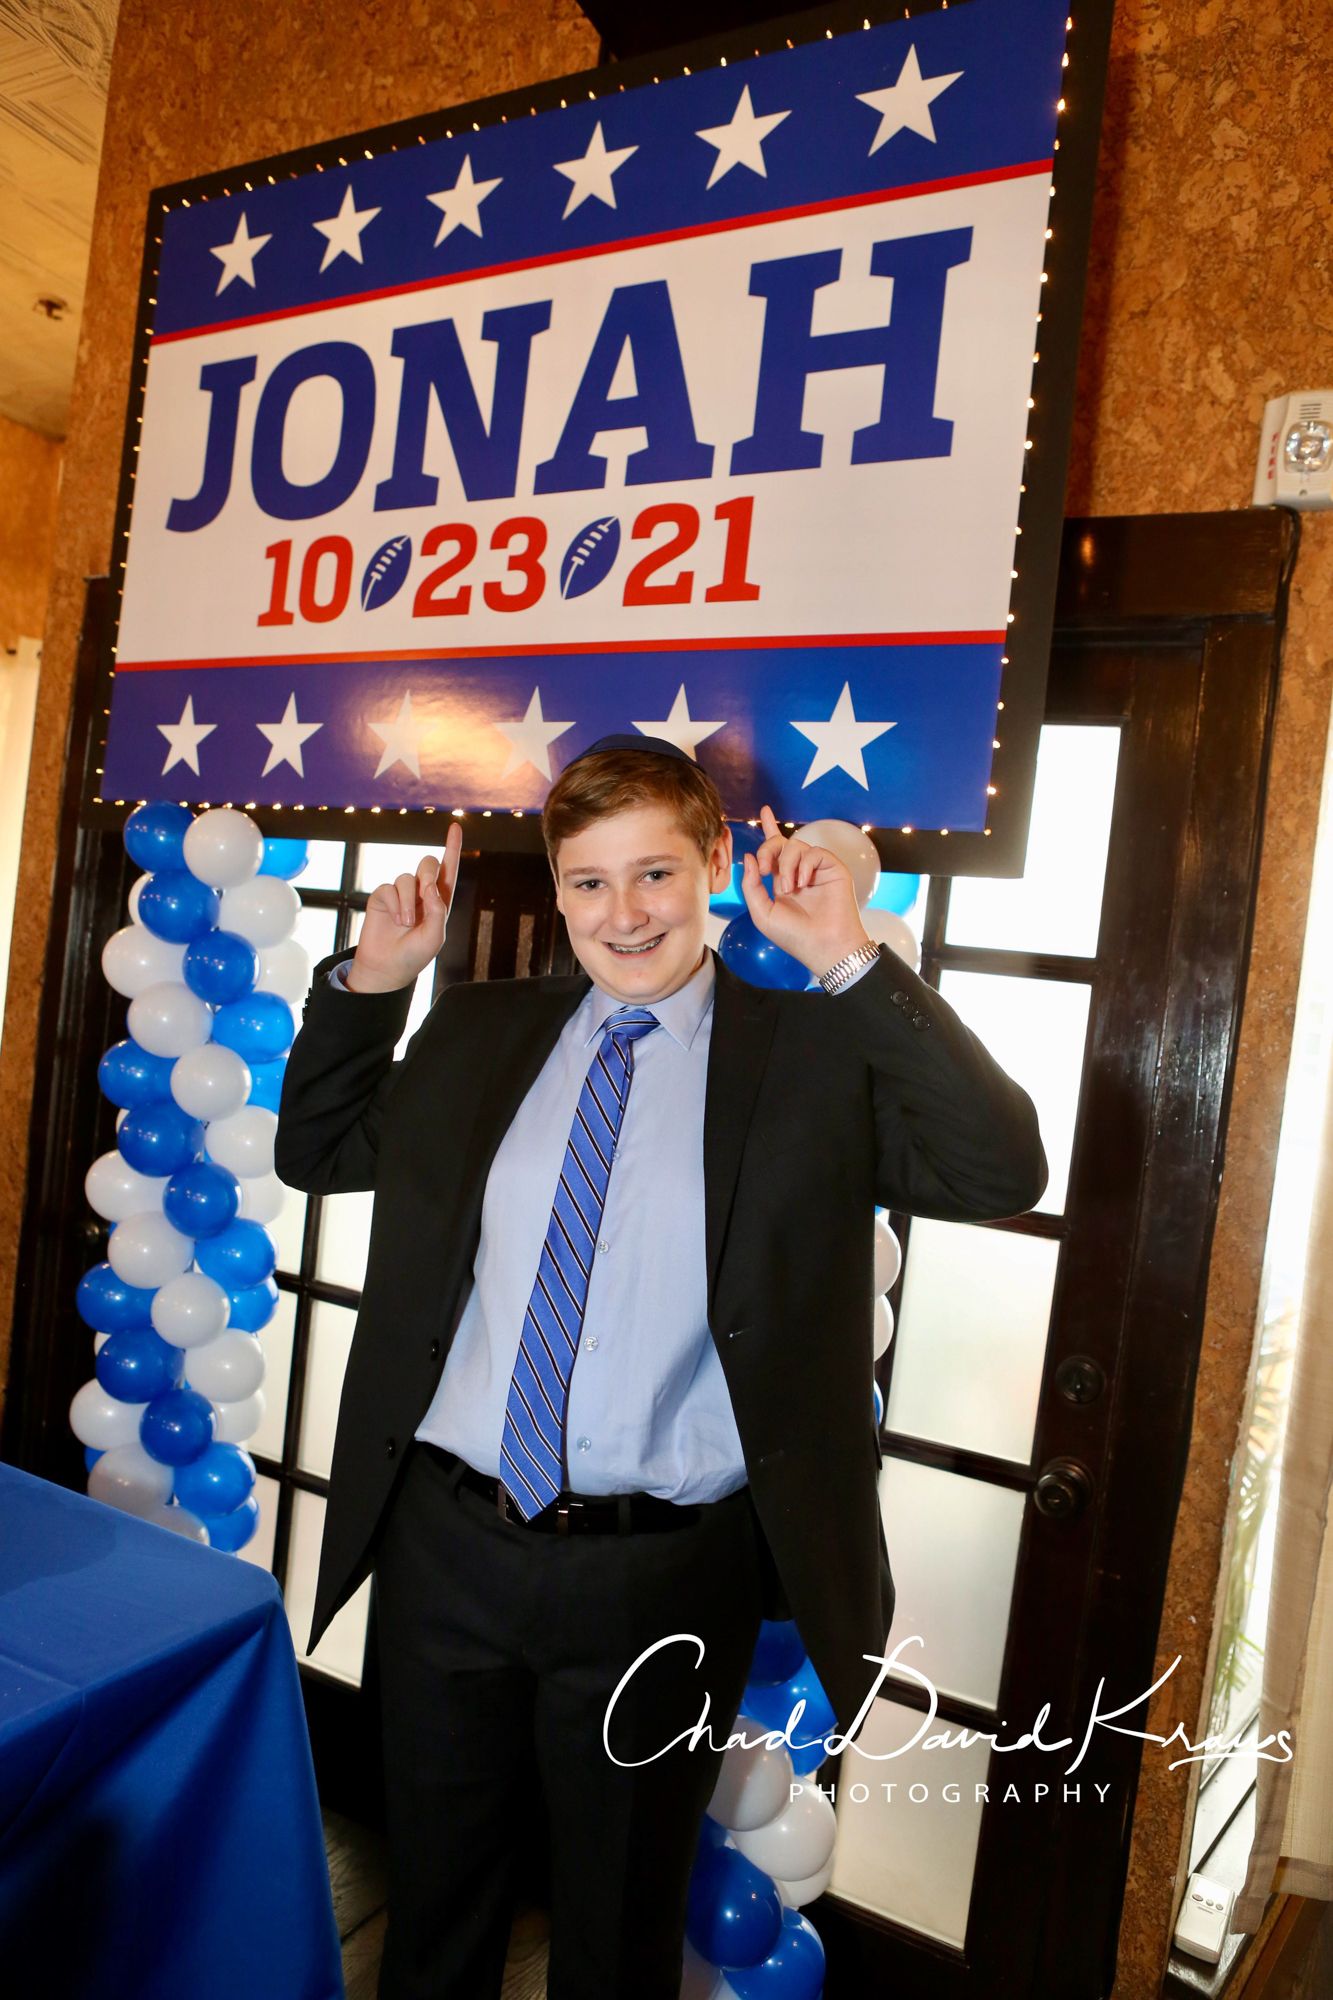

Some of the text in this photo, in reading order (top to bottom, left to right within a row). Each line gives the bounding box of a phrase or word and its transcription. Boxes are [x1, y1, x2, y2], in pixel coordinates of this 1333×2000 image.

[167, 226, 974, 533] JONAH
[256, 495, 762, 628] 10 23 21
